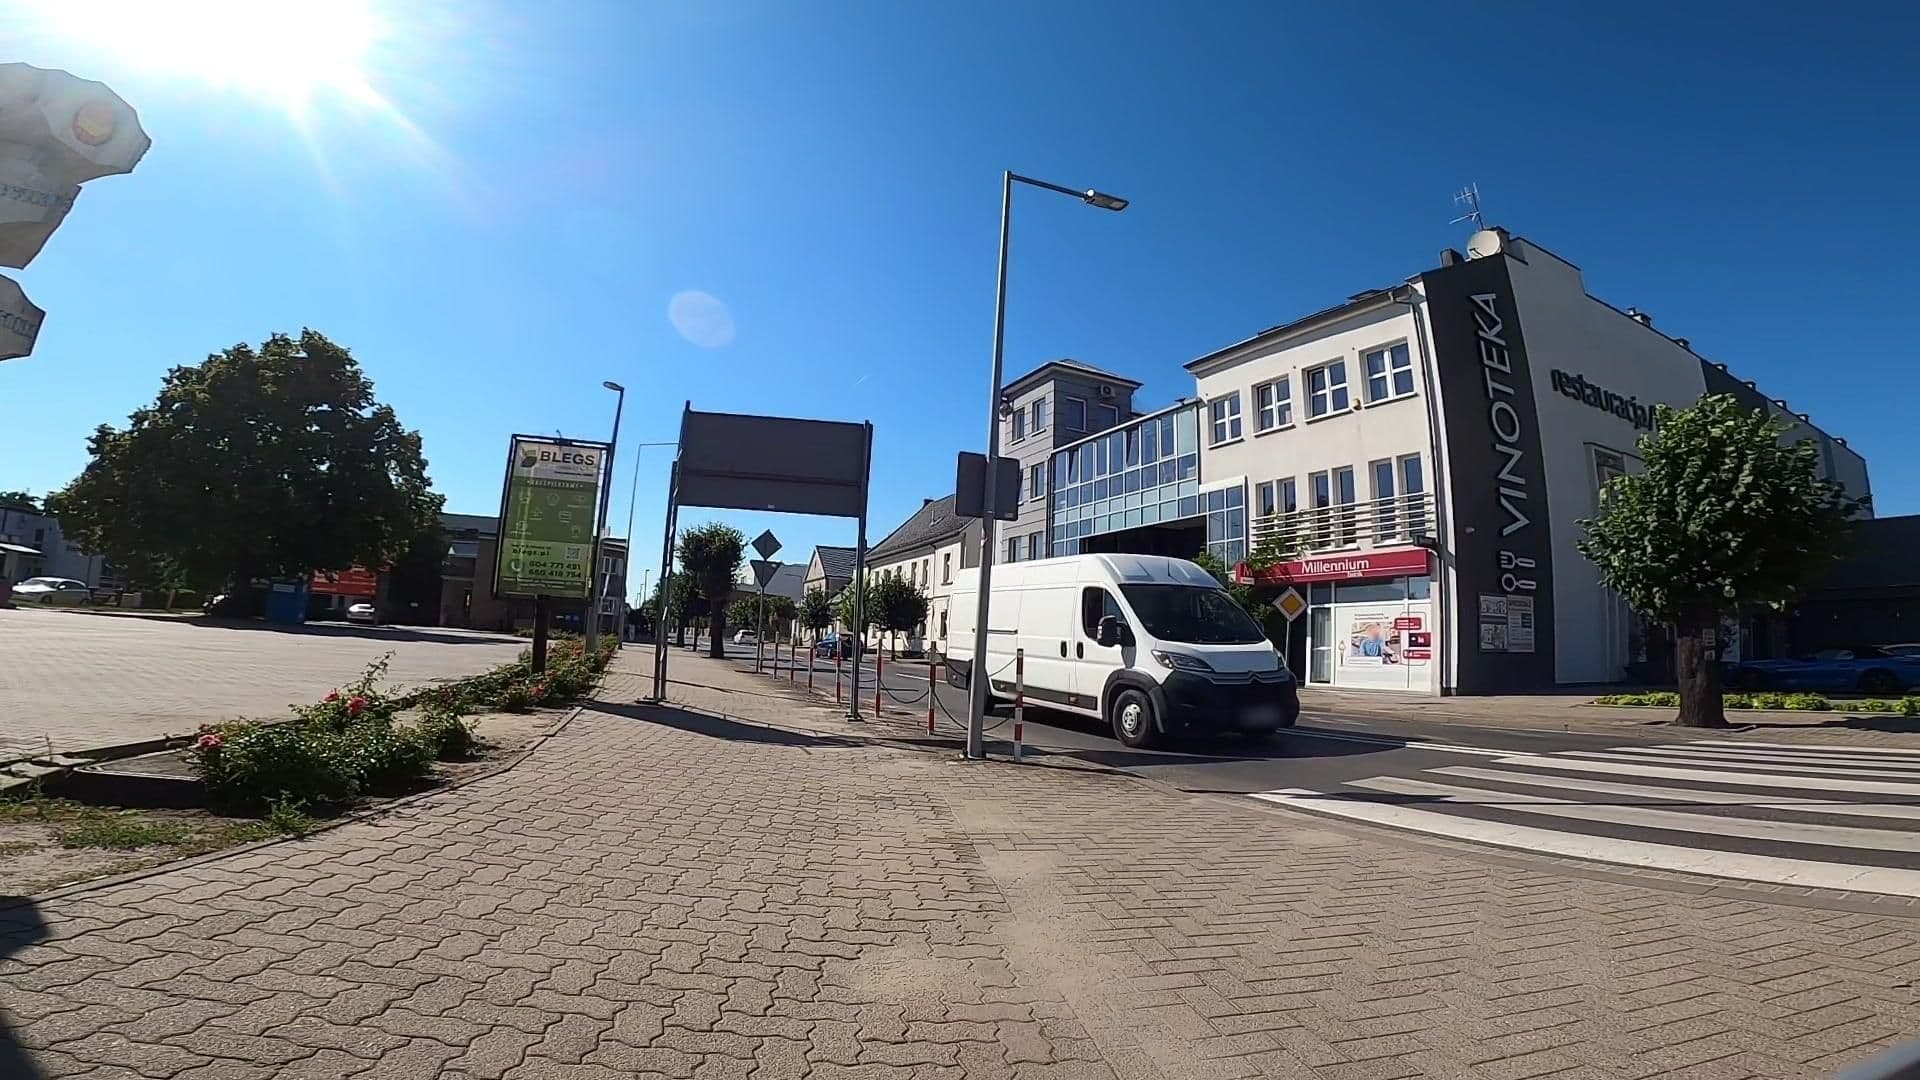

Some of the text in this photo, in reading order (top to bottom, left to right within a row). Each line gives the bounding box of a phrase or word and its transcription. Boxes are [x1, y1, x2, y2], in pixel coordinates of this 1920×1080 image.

[1470, 292, 1531, 537] VINOTEKA
[540, 450, 596, 466] BLEGS
[1301, 559, 1370, 575] Millennium
